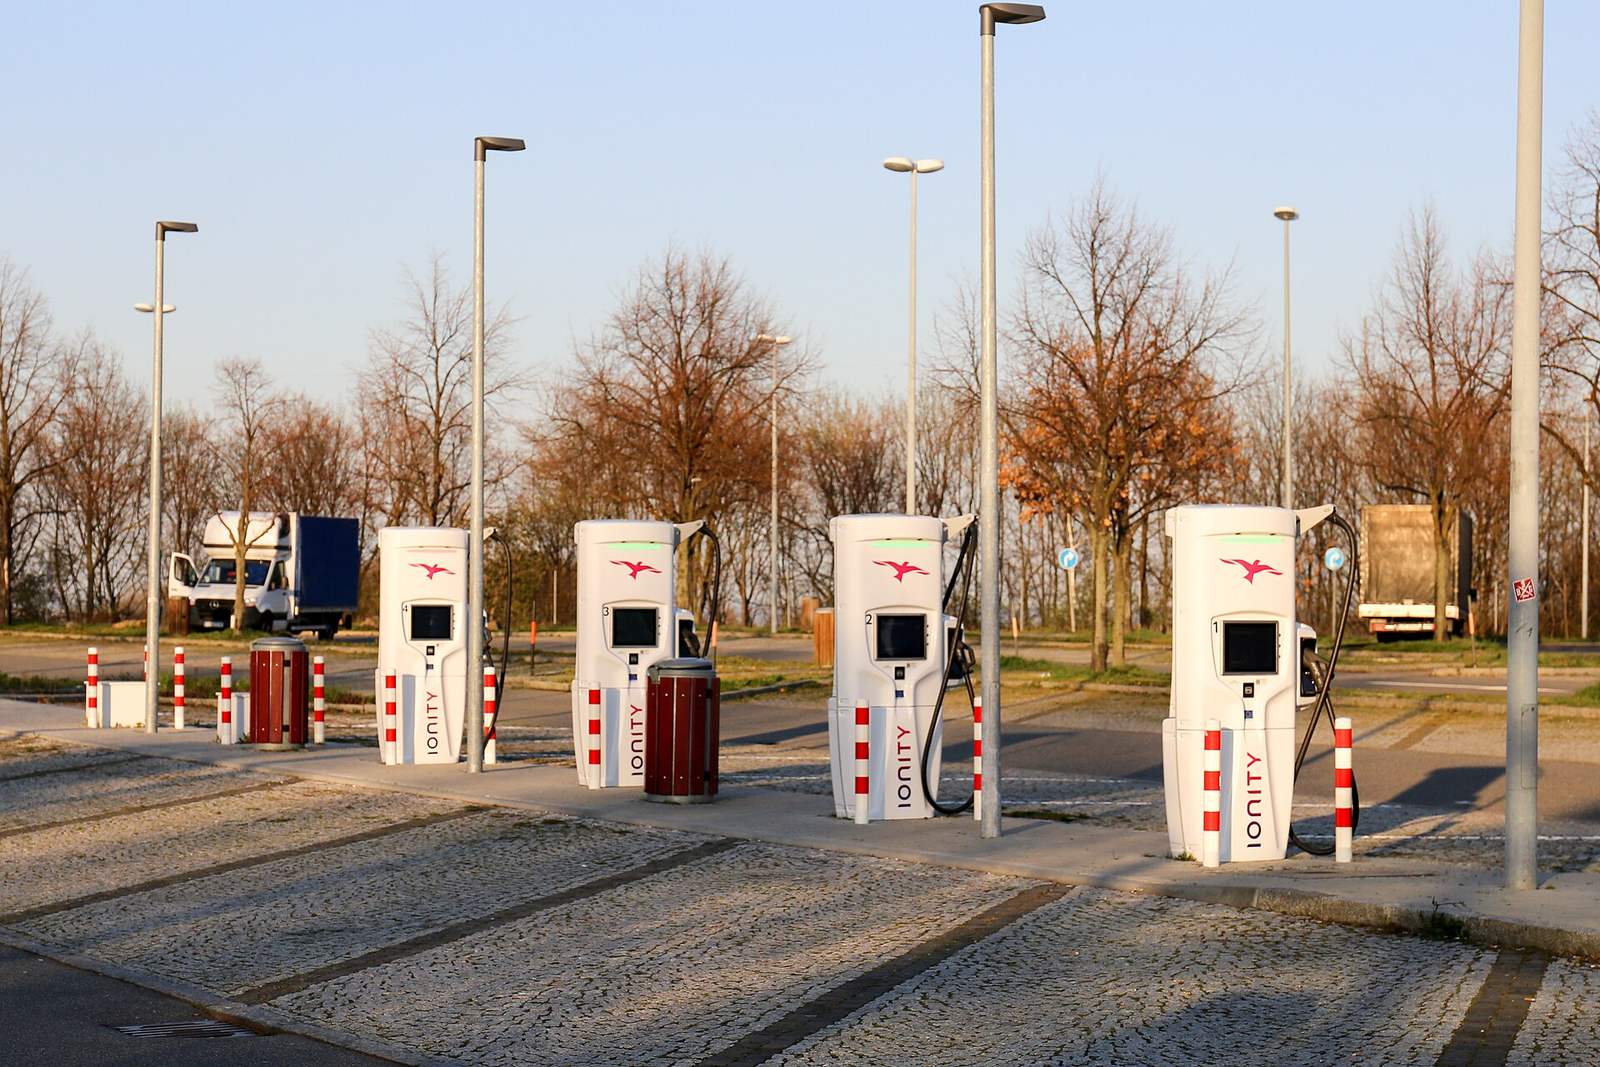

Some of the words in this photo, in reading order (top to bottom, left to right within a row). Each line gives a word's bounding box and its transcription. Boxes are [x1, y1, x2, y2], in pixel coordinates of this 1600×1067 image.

[603, 607, 610, 617] 3
[866, 614, 873, 625] 2
[1213, 621, 1220, 634] 1
[427, 691, 439, 755] IONITY
[631, 704, 644, 776] IONITY
[897, 725, 912, 808] IONITY
[1247, 752, 1262, 848] IONITY
